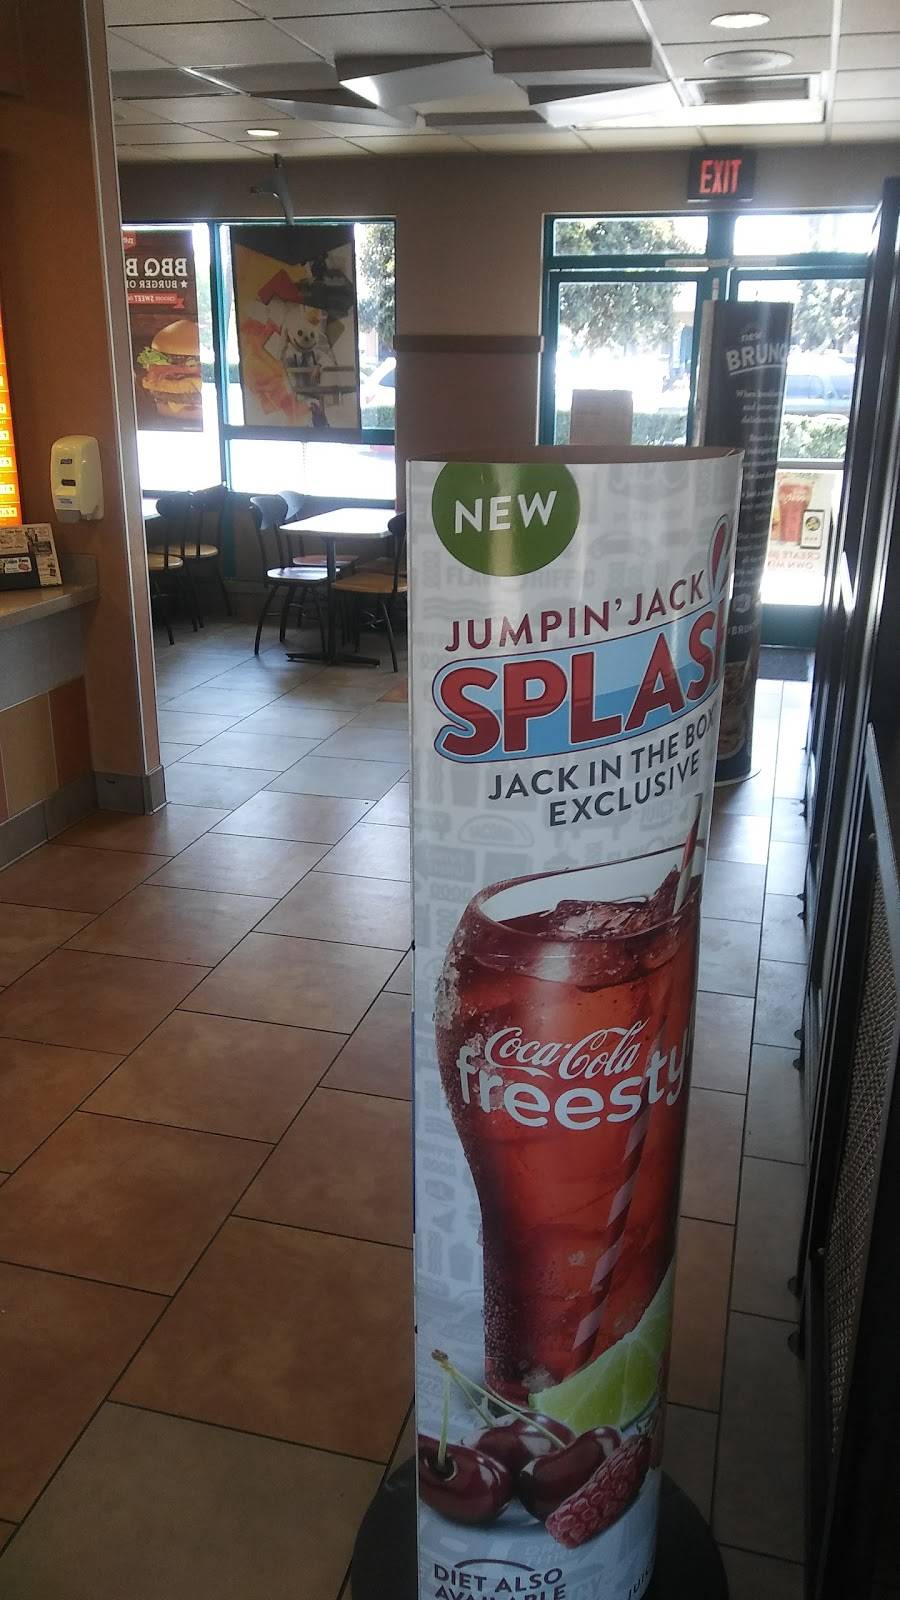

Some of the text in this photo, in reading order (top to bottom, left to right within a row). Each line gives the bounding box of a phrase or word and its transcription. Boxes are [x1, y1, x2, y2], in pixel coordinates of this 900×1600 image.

[699, 159, 742, 194] EXIT
[454, 490, 558, 534] NEW
[445, 597, 623, 652] JUMPIN'
[629, 569, 705, 625] JACK
[488, 710, 715, 800] JACK IN THE BOX
[548, 750, 700, 827] EXCLUSIVE
[433, 1563, 563, 1593] DIET ALSO
